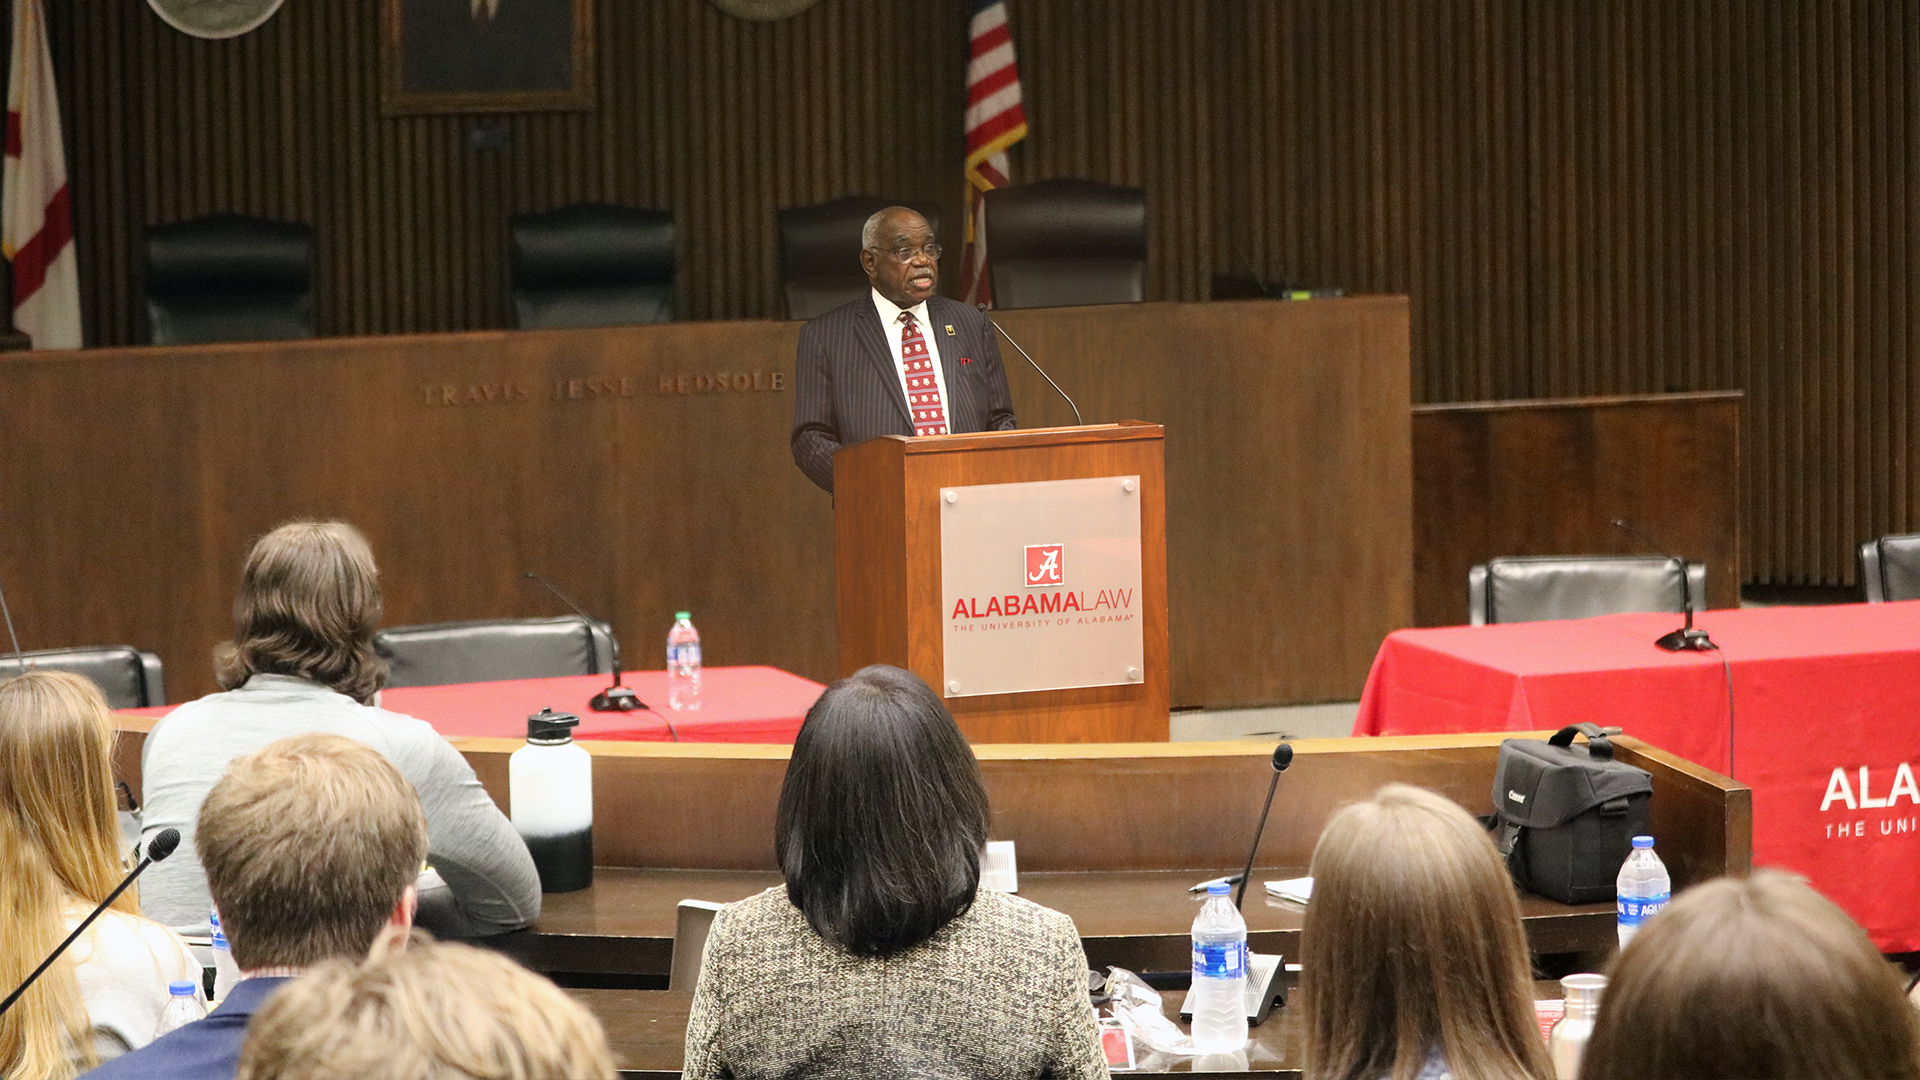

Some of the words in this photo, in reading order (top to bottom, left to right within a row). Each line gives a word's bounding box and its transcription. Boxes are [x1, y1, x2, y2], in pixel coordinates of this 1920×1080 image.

[954, 624, 975, 632] THE
[981, 619, 1051, 631] UNIVERSITY
[1057, 618, 1071, 626] OF
[1820, 762, 1920, 811] ALA
[1826, 820, 1865, 838] THE
